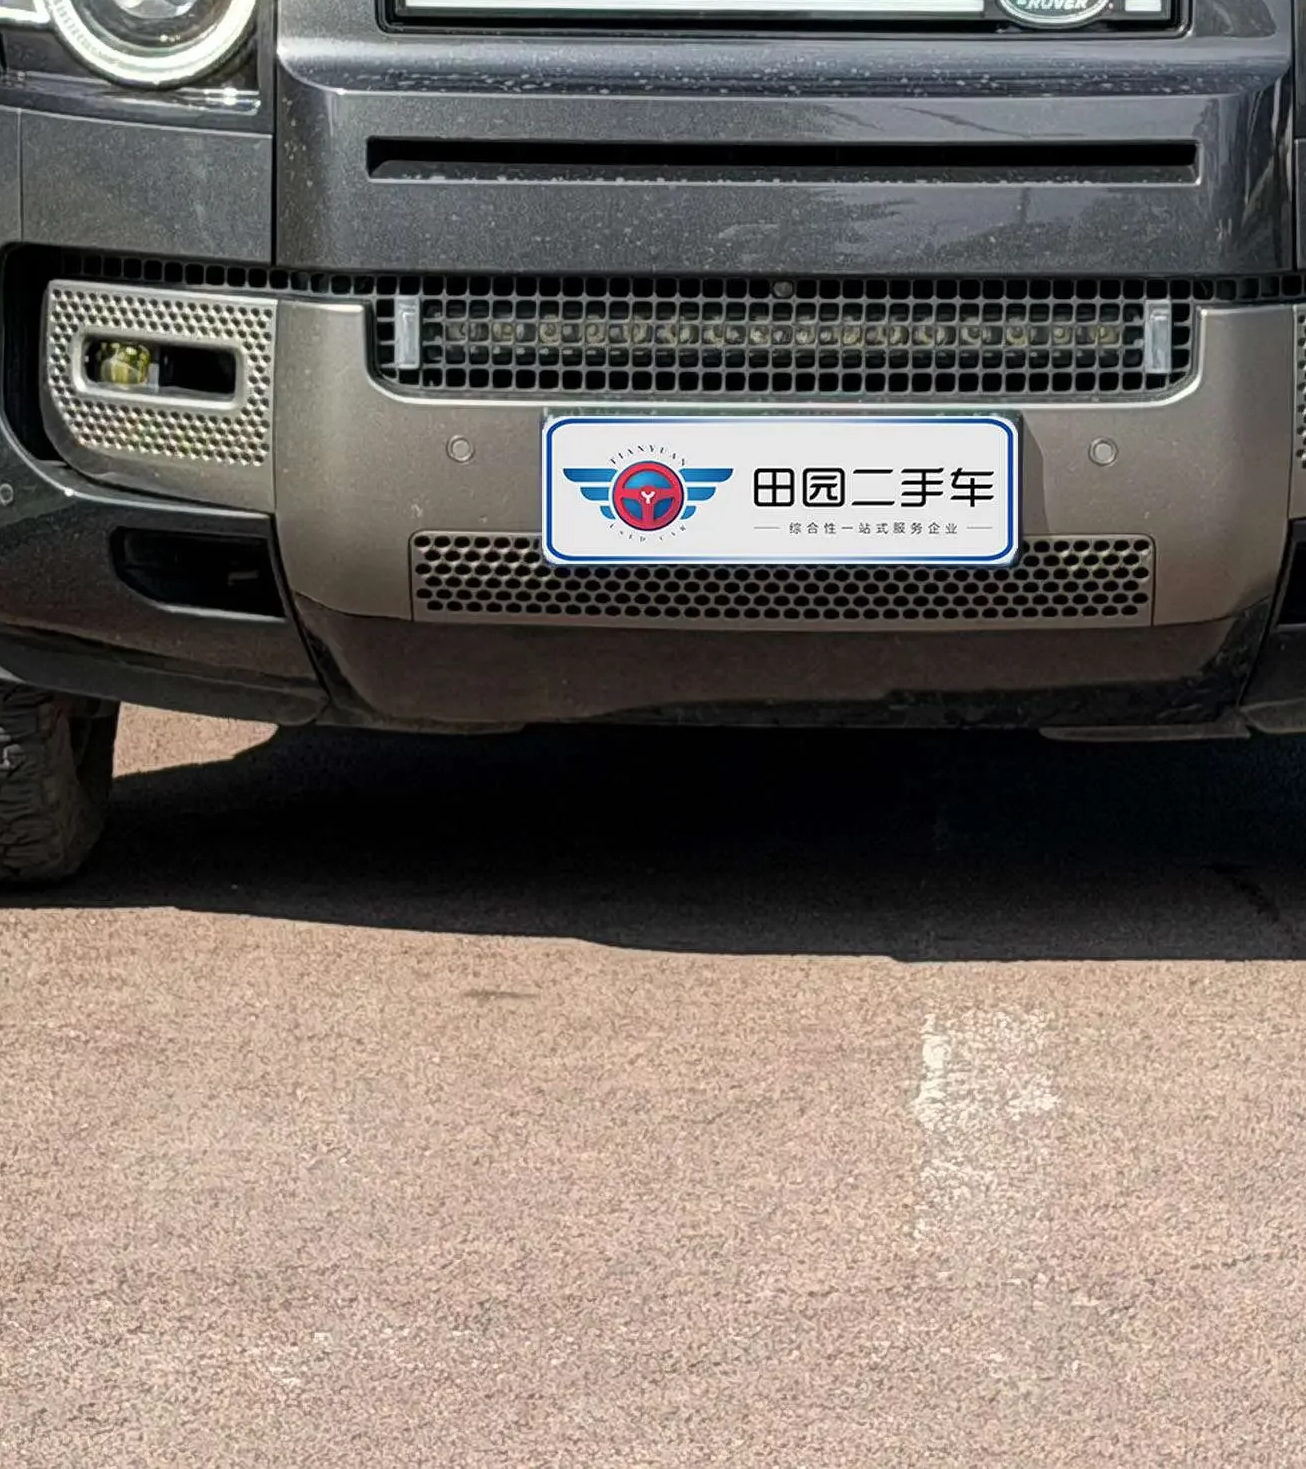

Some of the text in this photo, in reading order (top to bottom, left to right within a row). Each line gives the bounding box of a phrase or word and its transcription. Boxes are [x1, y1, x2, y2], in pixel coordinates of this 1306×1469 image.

[753, 467, 995, 508] 田园二手车
[788, 522, 958, 535] 综合性一站式服务企业
